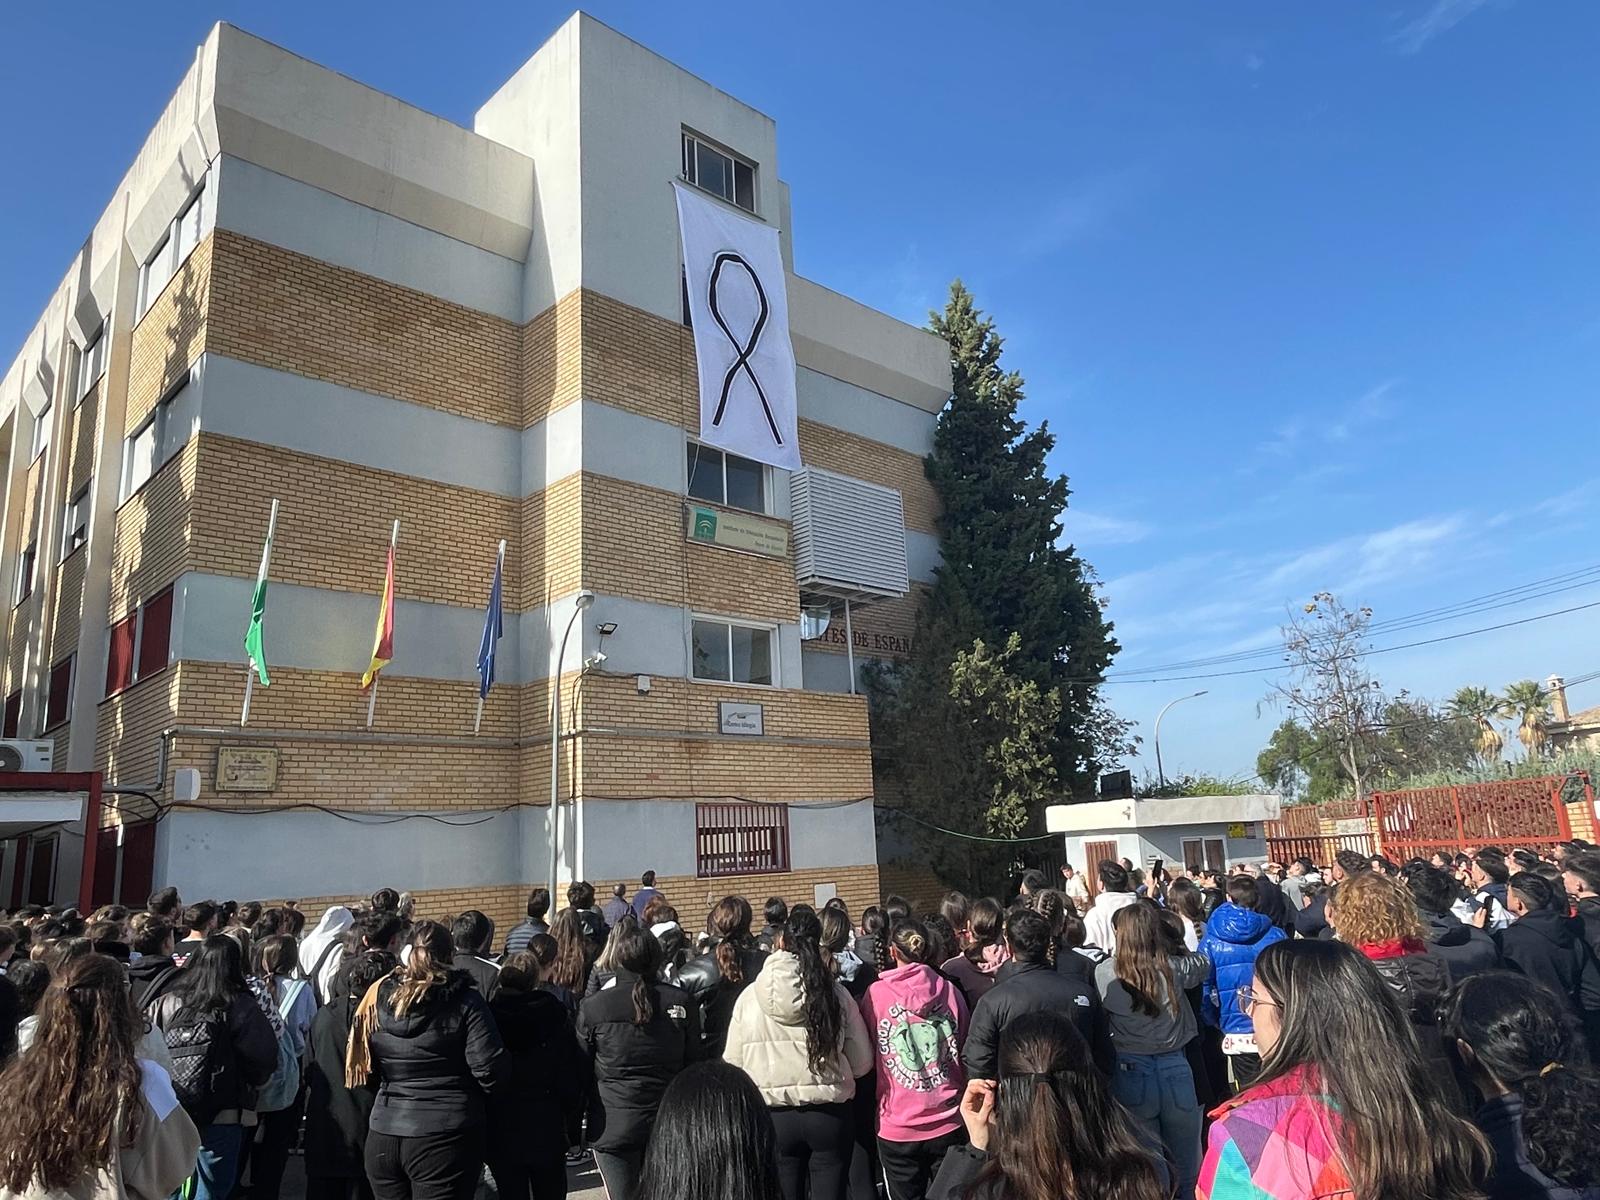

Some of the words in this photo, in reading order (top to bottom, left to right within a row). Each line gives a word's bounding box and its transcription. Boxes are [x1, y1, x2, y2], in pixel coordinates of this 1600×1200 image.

[853, 630, 869, 647] DE
[874, 634, 910, 653] ESPAÑ
[878, 1018, 892, 1055] GOOD
